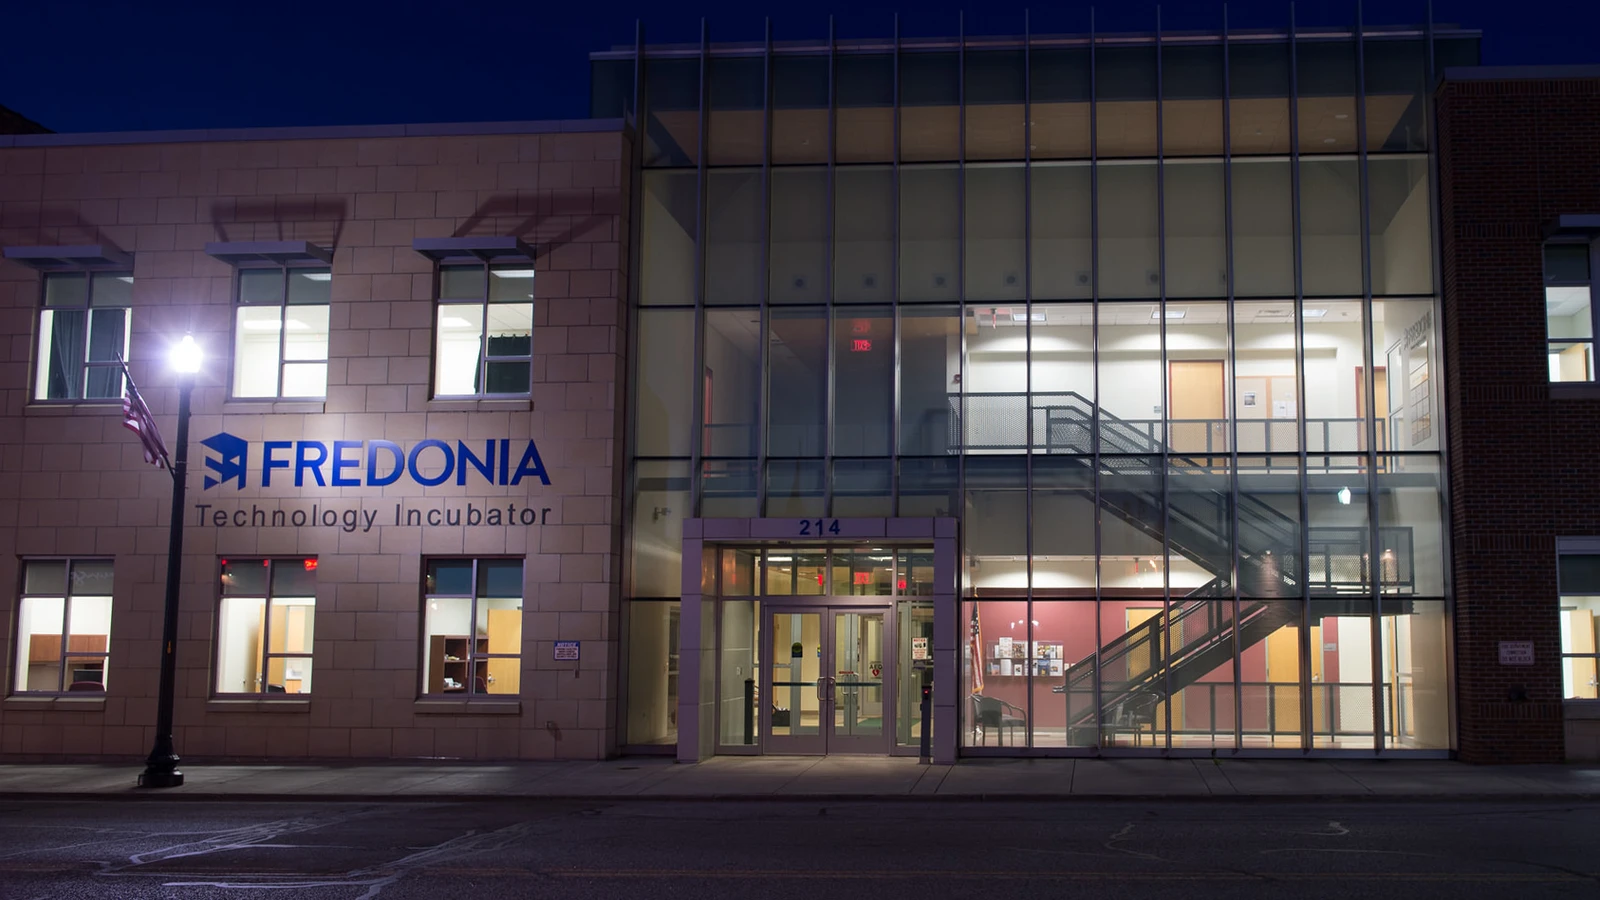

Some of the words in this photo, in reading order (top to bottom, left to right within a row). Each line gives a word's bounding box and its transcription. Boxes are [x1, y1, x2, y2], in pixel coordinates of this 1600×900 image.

[261, 438, 552, 488] FREDONIA
[195, 503, 378, 532] Technology
[395, 503, 552, 526] Incubator
[799, 519, 841, 536] 214
